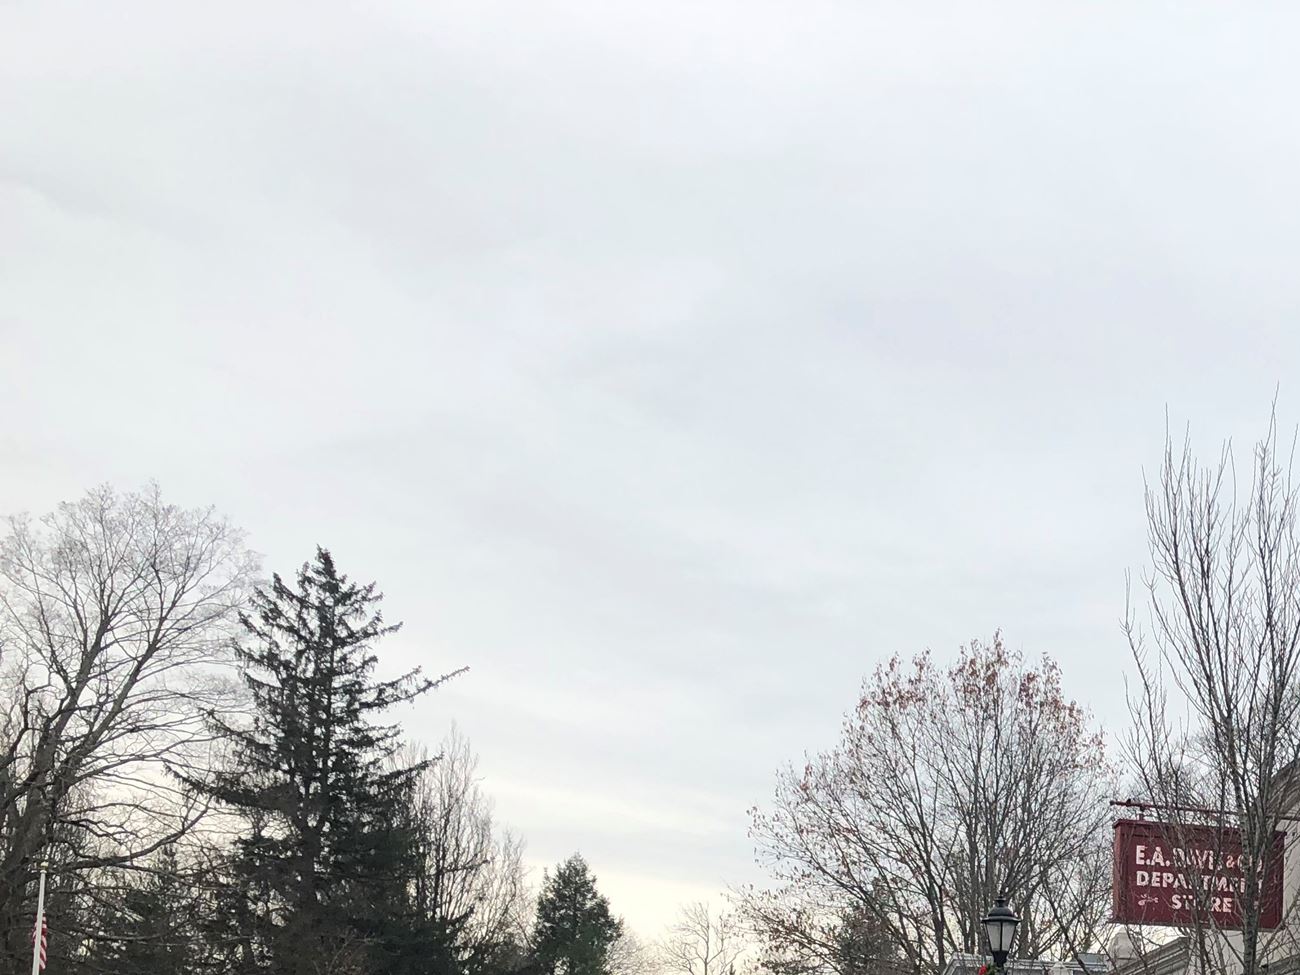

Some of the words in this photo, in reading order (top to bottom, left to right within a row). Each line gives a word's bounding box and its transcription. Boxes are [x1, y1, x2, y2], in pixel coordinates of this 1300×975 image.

[1135, 844, 1170, 867] E.A.
[1226, 854, 1236, 870] &
[1171, 894, 1233, 913] STRE
